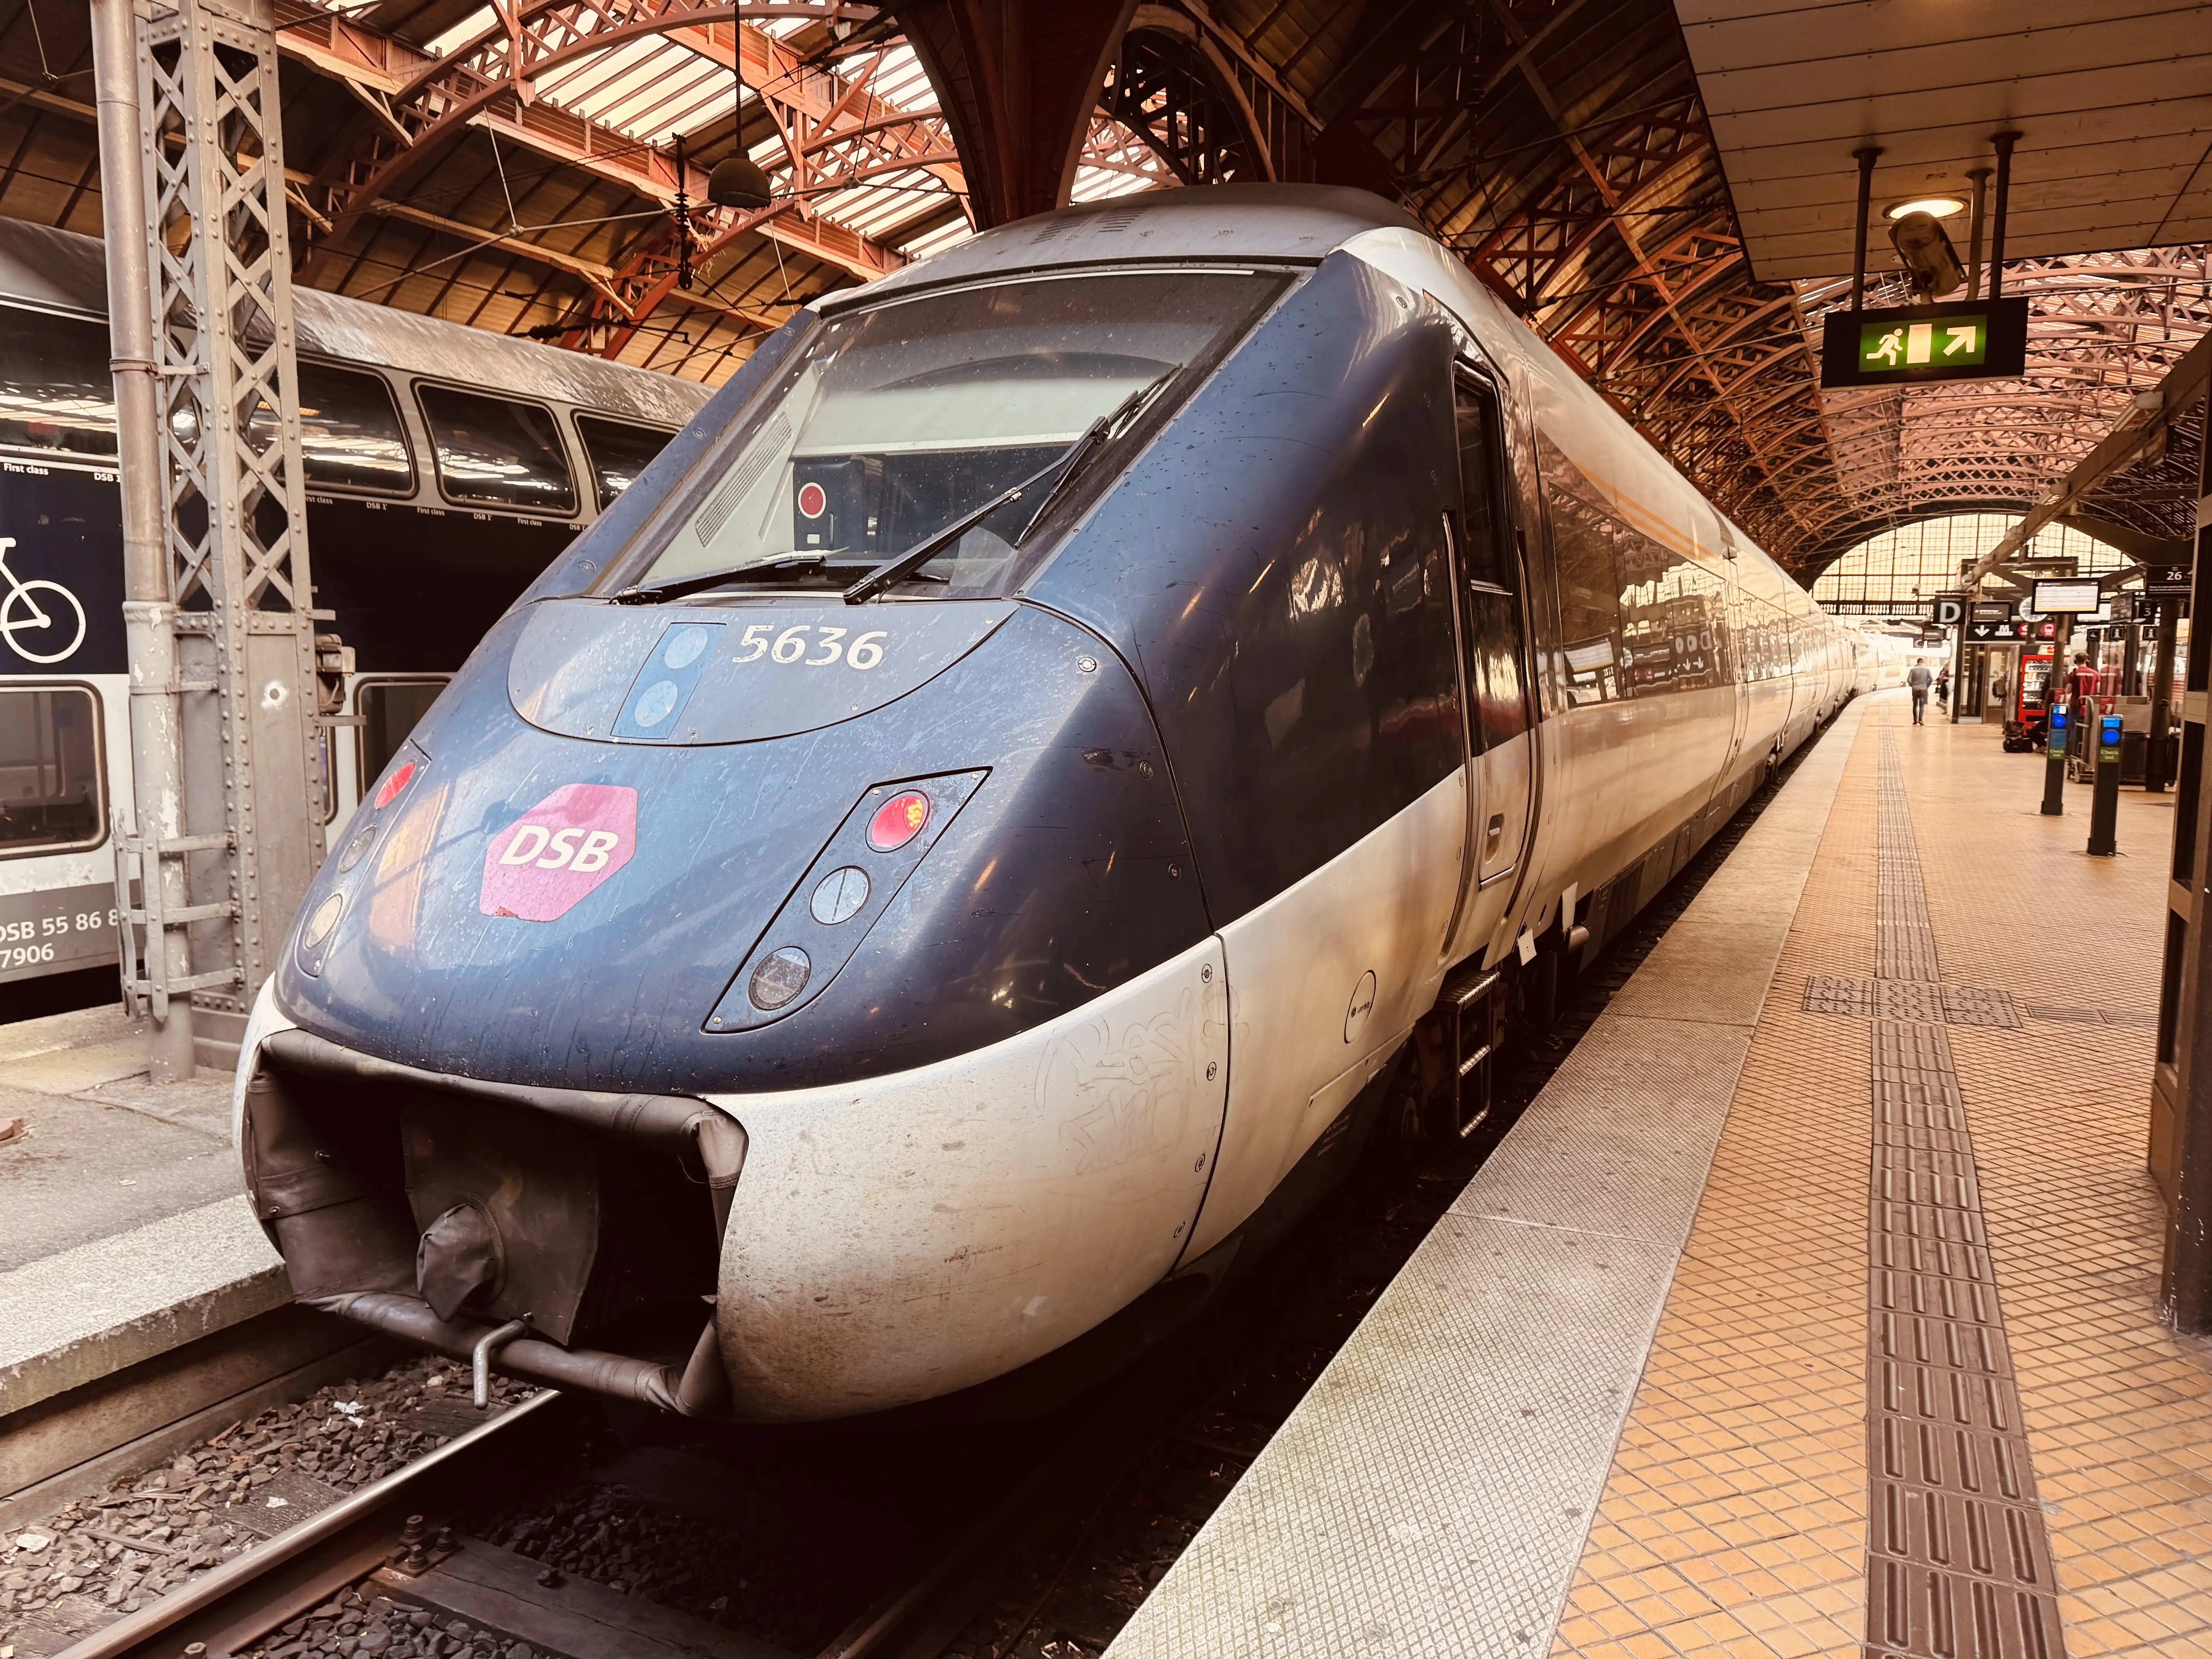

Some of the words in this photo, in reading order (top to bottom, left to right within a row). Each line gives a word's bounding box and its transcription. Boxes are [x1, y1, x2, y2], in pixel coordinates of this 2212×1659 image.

[4, 463, 24, 473] First
[26, 466, 49, 476] class
[94, 472, 114, 482] DSB
[317, 496, 333, 505] class
[366, 501, 381, 510] DSB
[417, 507, 429, 515] First
[530, 519, 542, 527] class
[2167, 571, 2183, 580] 26
[1940, 602, 1961, 623] D
[732, 625, 888, 670] 5636
[498, 825, 619, 872] DSB
[42, 916, 69, 936] 55
[76, 911, 102, 931] 86
[108, 908, 118, 926] 8
[0, 942, 54, 969] 7906
